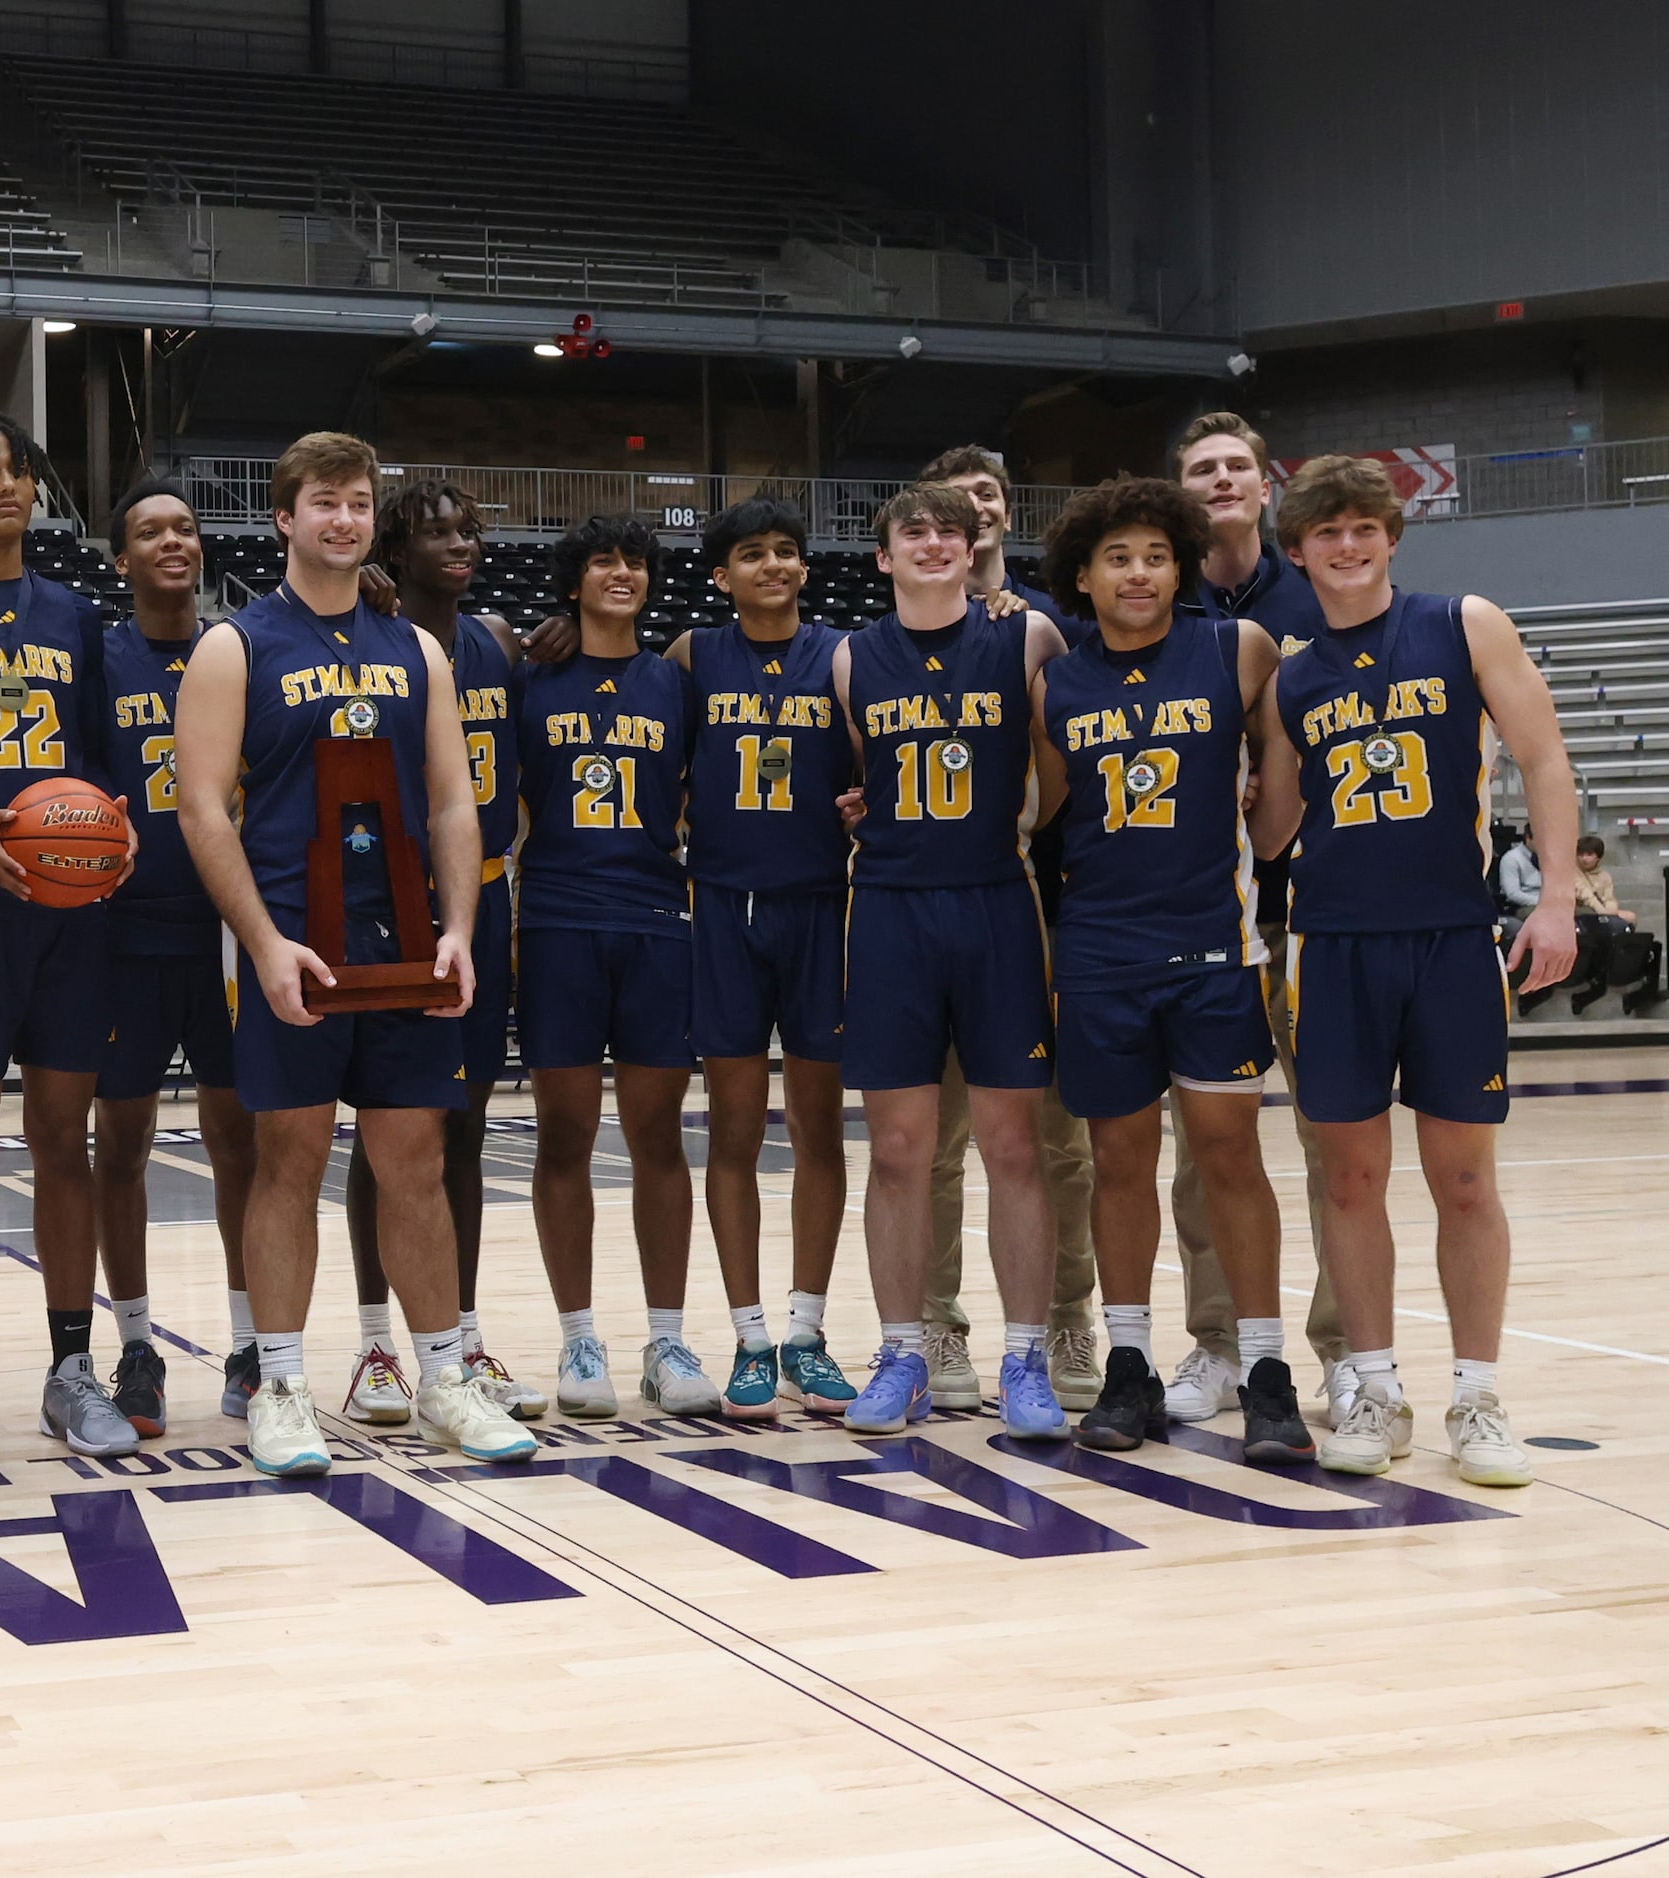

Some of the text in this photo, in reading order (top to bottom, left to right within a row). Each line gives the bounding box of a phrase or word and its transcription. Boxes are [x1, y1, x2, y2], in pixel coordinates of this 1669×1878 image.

[665, 507, 695, 527] 108
[1066, 698, 1213, 753] ST.MRK'S
[466, 731, 497, 806] 3
[572, 754, 644, 829] 21
[735, 734, 794, 812] 11
[895, 740, 974, 821] 10
[1097, 747, 1181, 834] 12
[1325, 731, 1434, 830] 23
[41, 803, 120, 828] Baden
